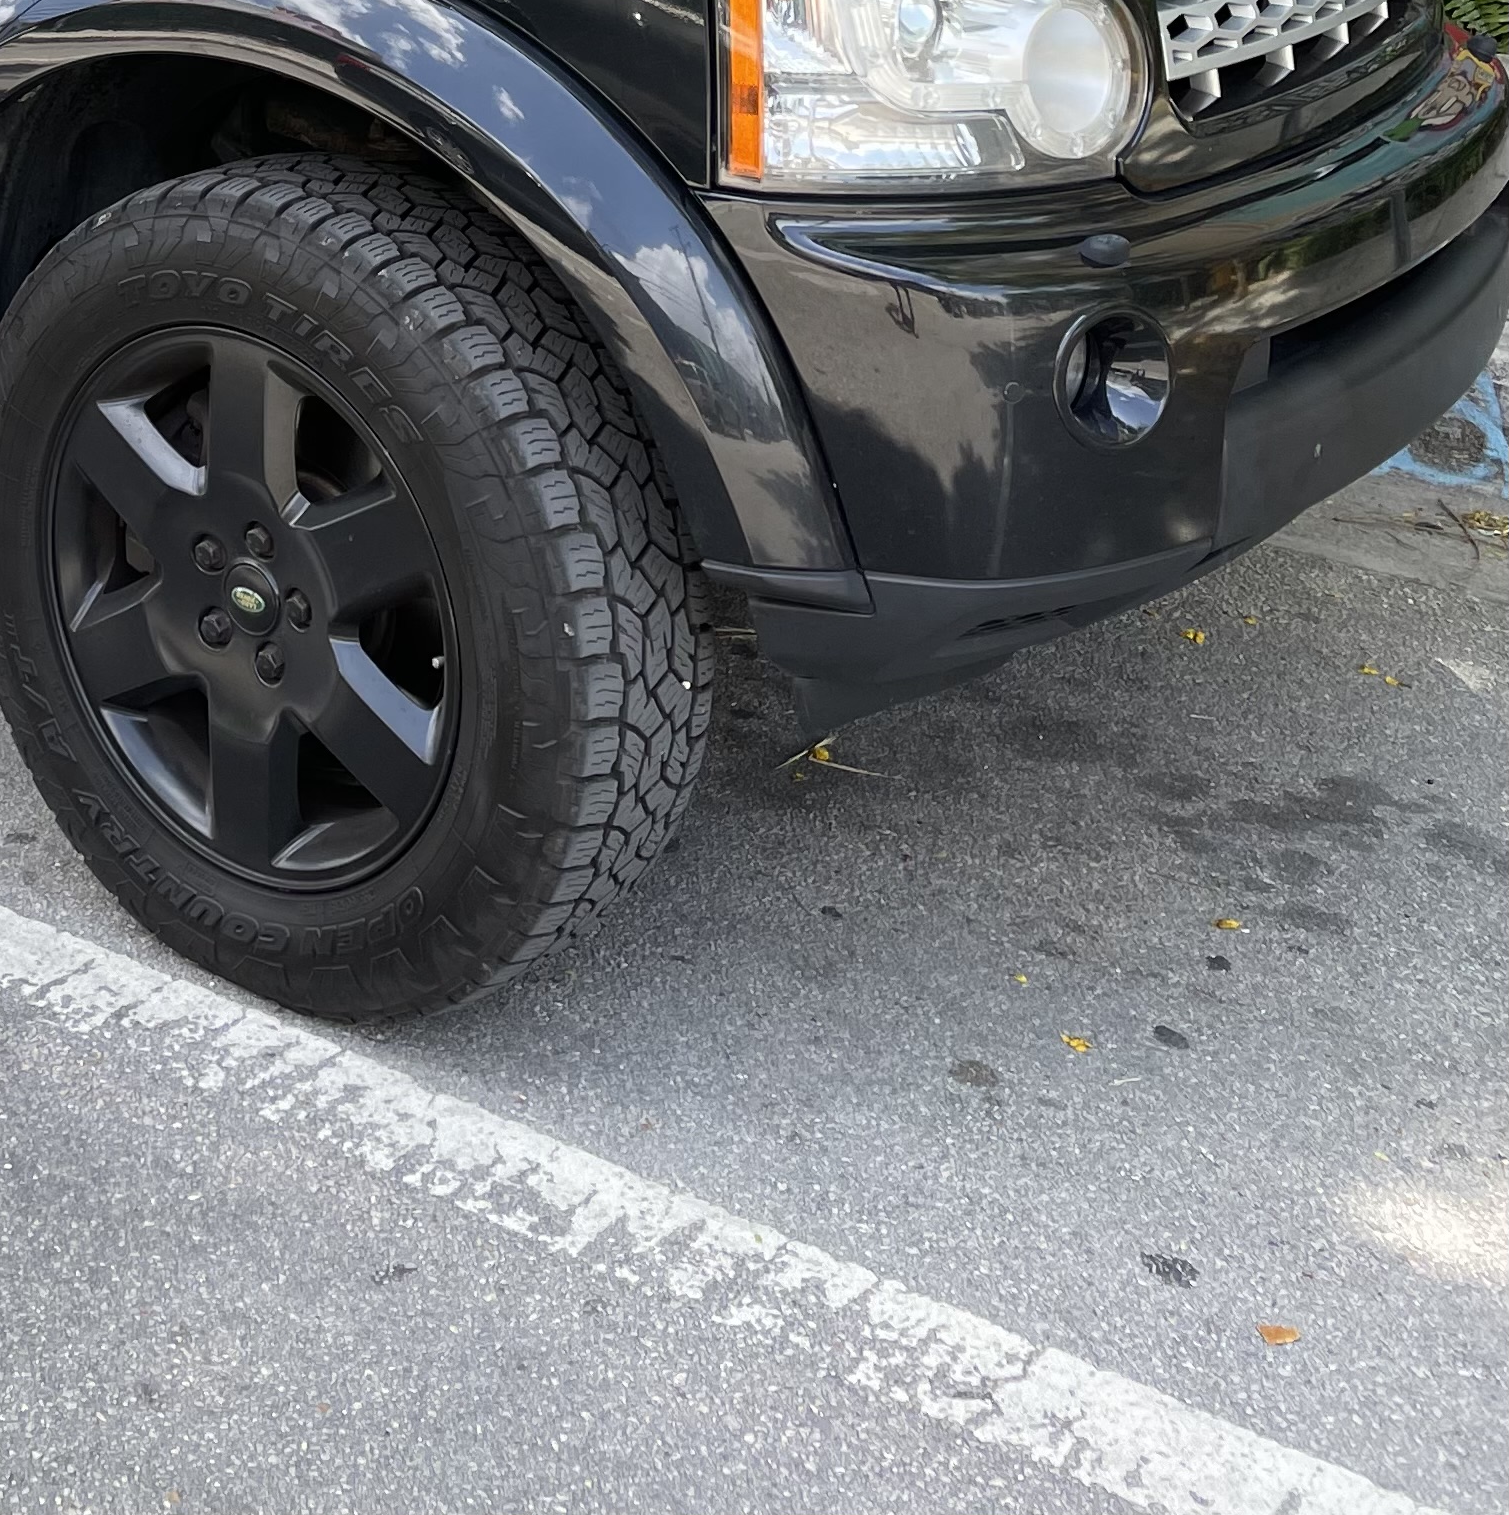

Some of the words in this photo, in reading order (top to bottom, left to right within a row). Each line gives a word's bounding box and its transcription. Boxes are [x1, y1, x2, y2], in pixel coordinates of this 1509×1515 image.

[117, 269, 254, 306] TOYO
[263, 291, 426, 445] TIRES
[71, 788, 292, 952] COUNTRY
[299, 885, 426, 957] OPEN
